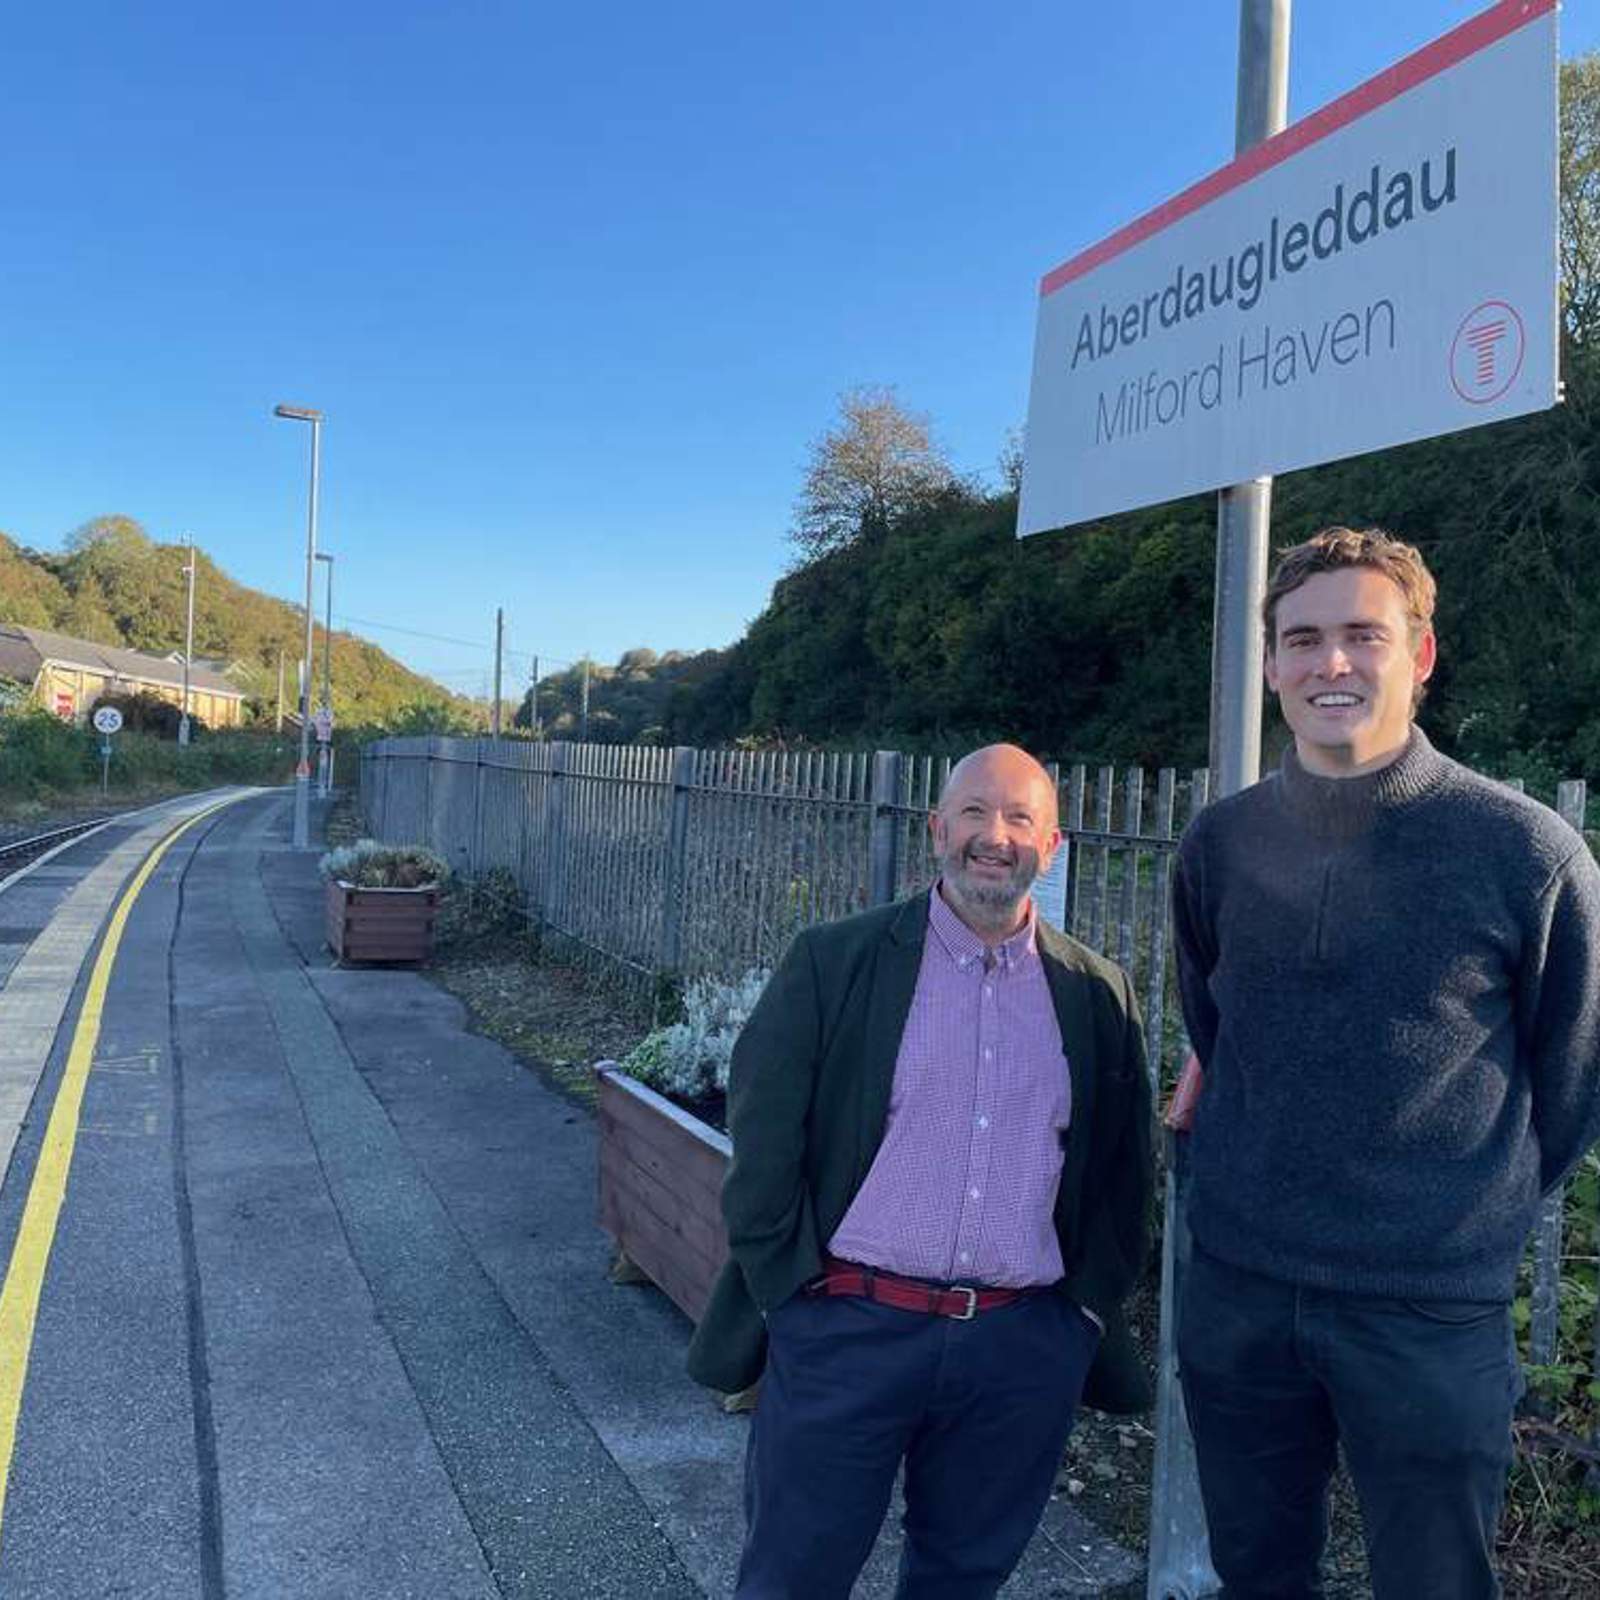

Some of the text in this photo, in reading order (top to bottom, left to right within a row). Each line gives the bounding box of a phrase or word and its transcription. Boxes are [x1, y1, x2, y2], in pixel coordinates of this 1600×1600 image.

[1070, 146, 1457, 370] Aberdaugleddau
[1094, 298, 1396, 445] Milford Haven
[99, 711, 118, 728] 25
